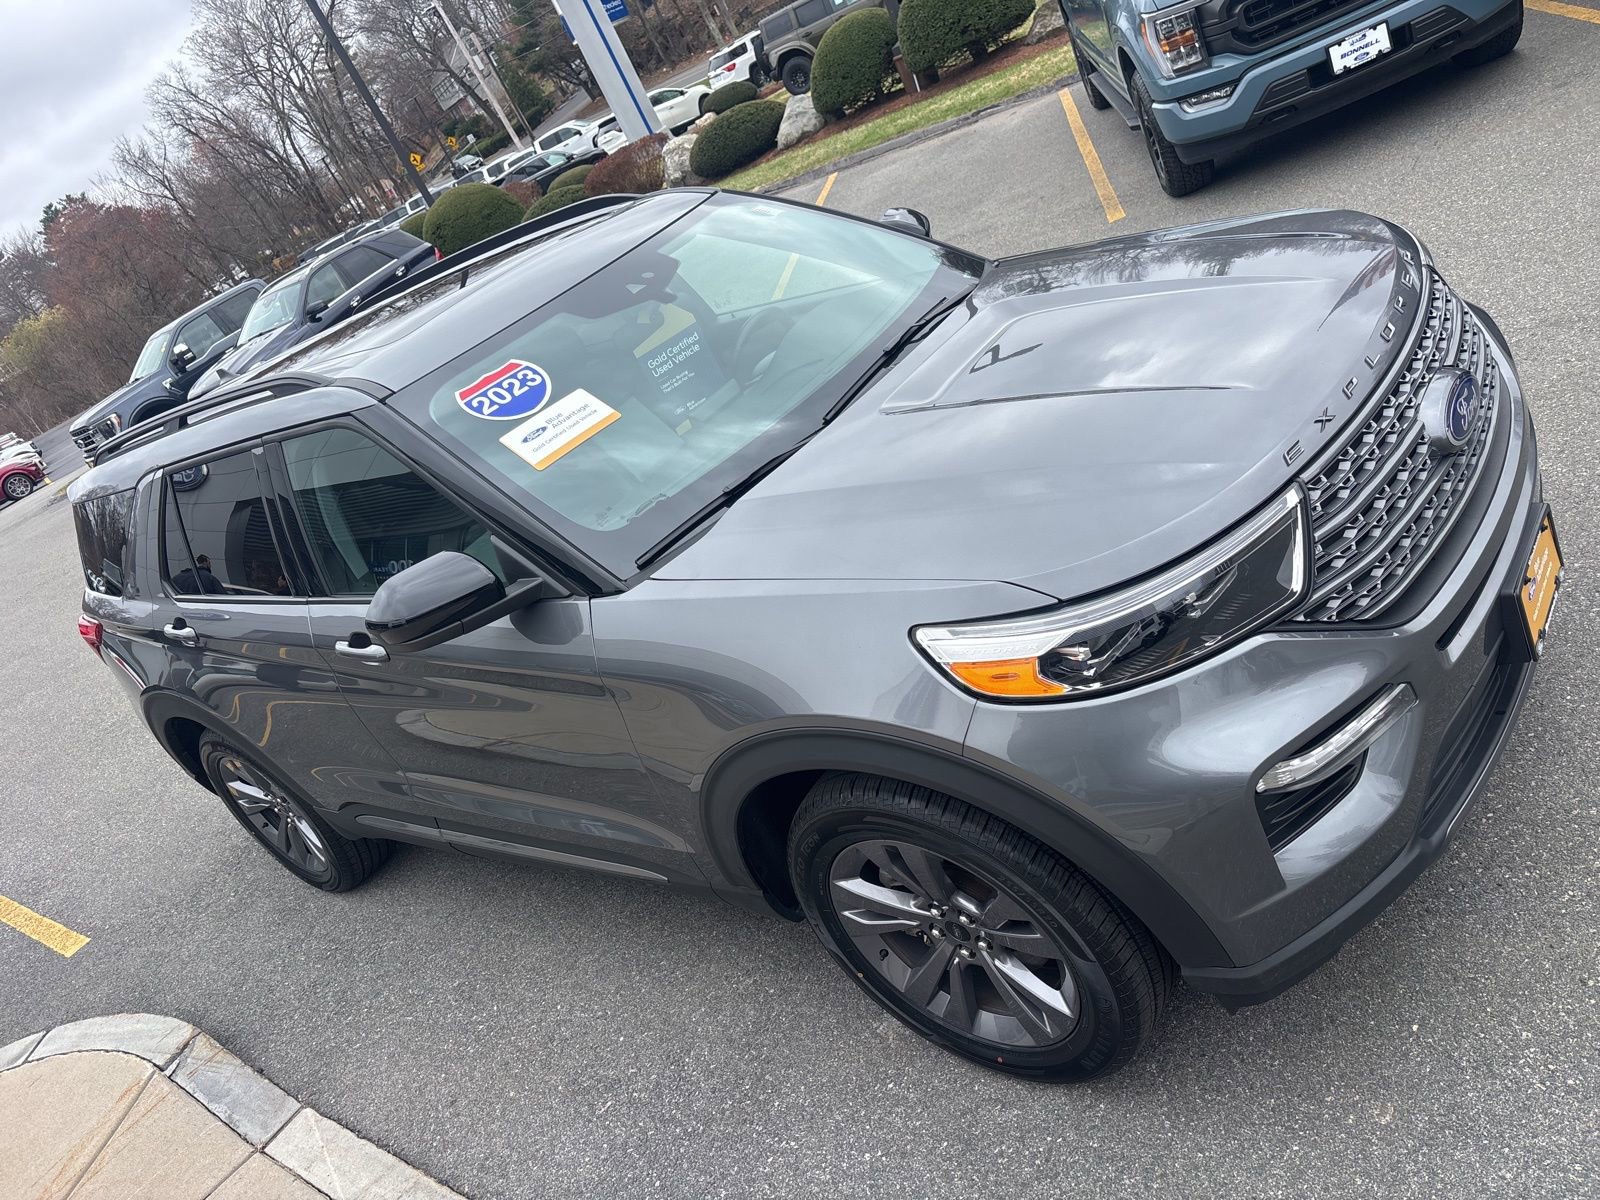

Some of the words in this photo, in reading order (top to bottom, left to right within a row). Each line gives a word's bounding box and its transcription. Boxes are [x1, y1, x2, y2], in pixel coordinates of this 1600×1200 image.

[1340, 38, 1381, 60] BONNELL
[648, 352, 667, 368] Gold
[667, 332, 699, 357] Certified
[652, 360, 674, 377] Used
[673, 344, 700, 363] Vehicle
[1283, 250, 1417, 467] EXPLORER
[472, 369, 543, 415] 2023
[1456, 386, 1479, 431] Ford
[532, 442, 546, 453] Gold
[546, 429, 567, 445] Certified
[566, 419, 581, 431] Used
[580, 409, 598, 422] Vehicle
[545, 412, 563, 425] Blue
[552, 403, 590, 429] Advantage
